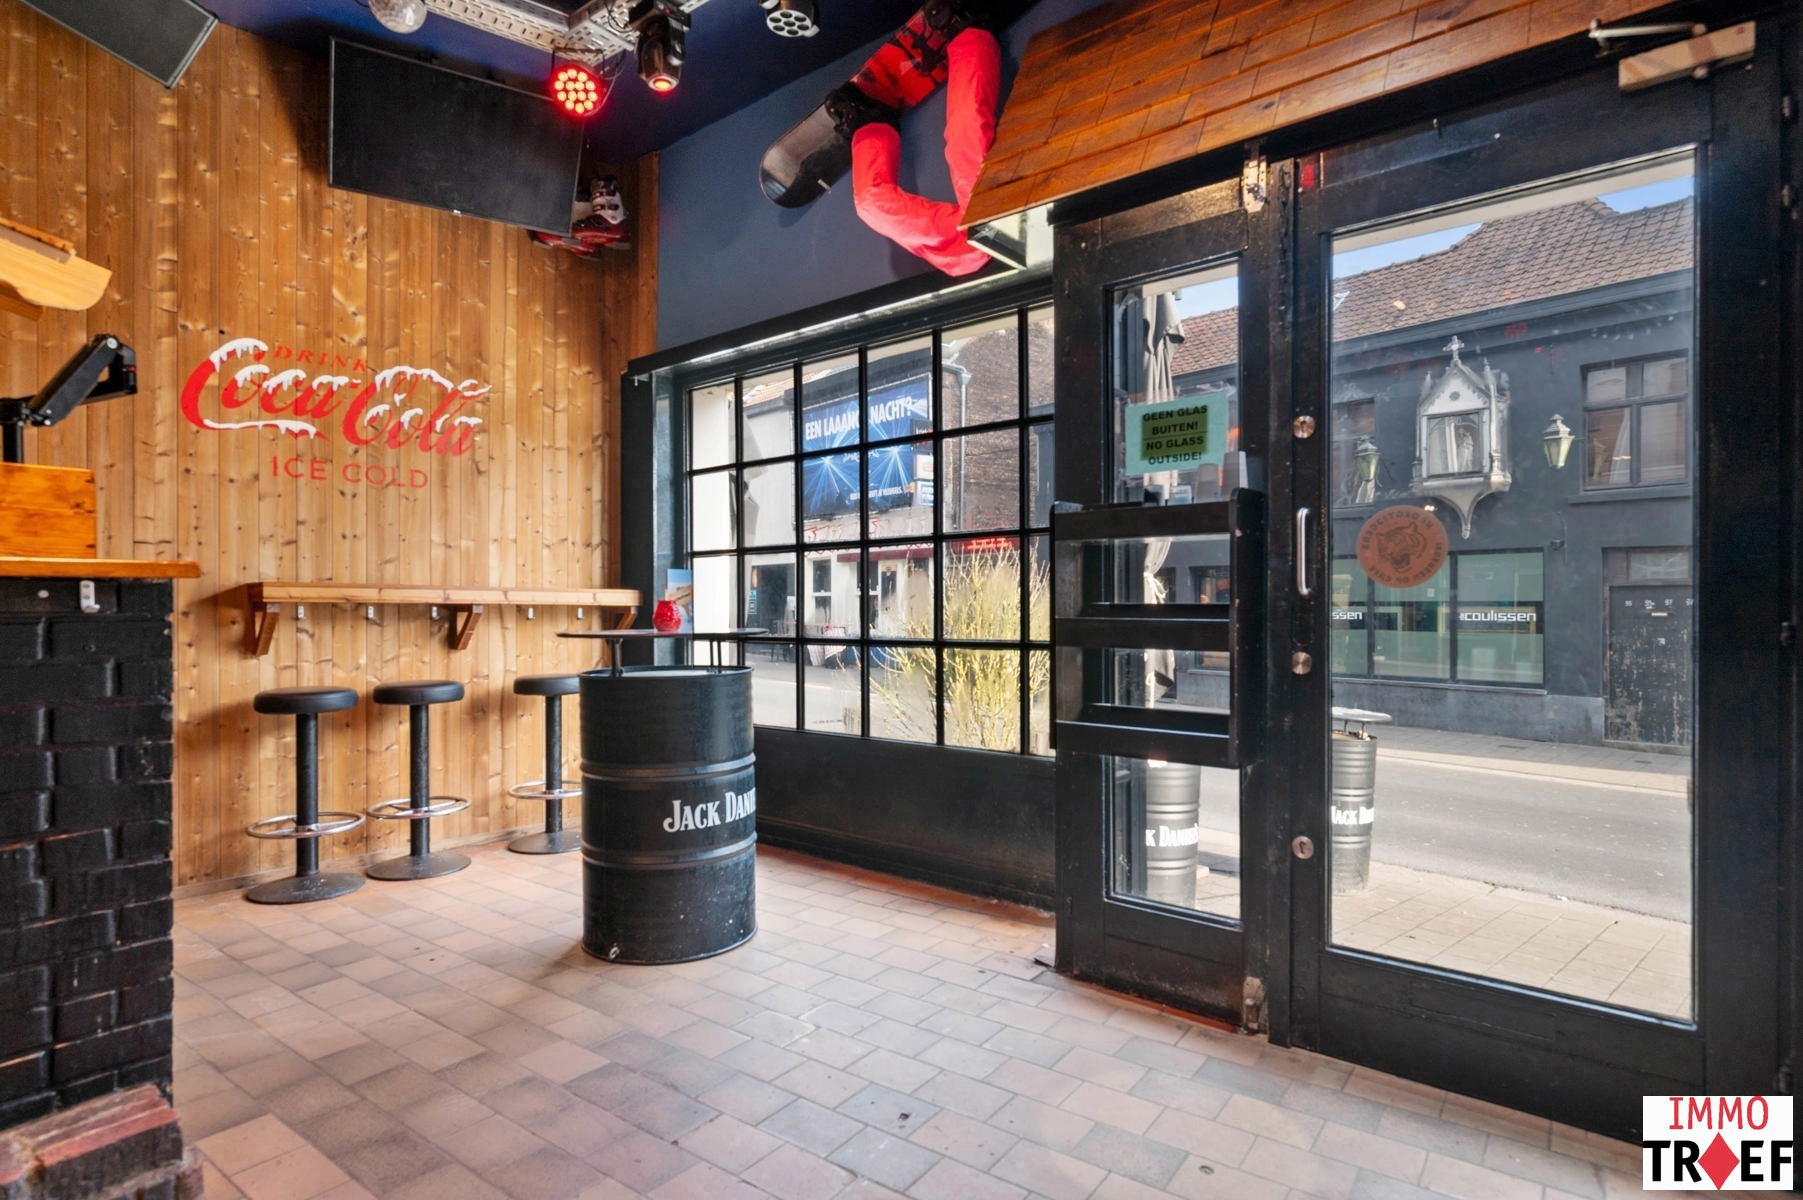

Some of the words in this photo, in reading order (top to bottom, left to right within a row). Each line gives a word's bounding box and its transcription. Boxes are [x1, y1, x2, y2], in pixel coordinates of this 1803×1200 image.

[276, 345, 368, 372] DRINK
[805, 420, 821, 440] EEN
[870, 396, 912, 424] NACHT?
[1143, 410, 1174, 422] GEEN
[1177, 405, 1208, 417] GLAS
[1151, 421, 1199, 435] BUITEN!
[1146, 440, 1163, 451] NO
[1166, 435, 1204, 448] GLASS
[1148, 451, 1202, 465] OUTSIDE!
[271, 455, 327, 480] ICE
[342, 463, 428, 488] COLD
[663, 800, 721, 832] JACK
